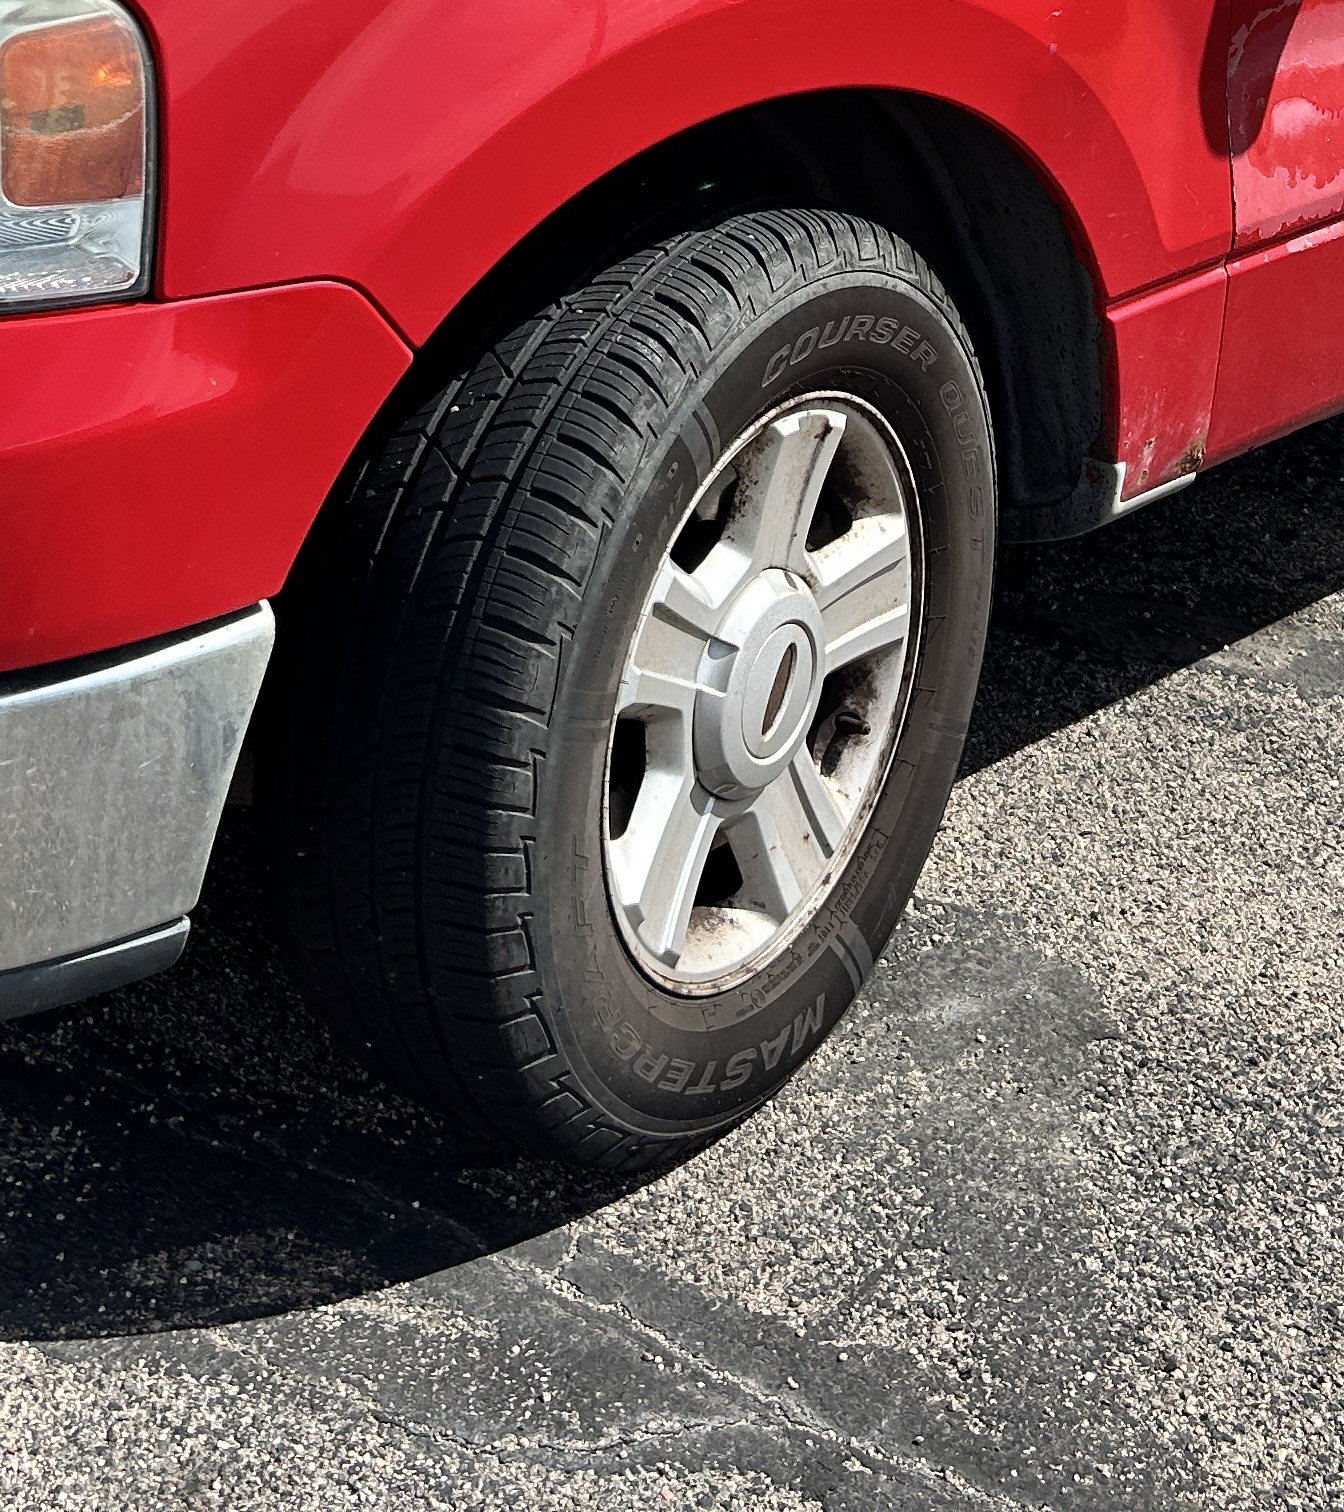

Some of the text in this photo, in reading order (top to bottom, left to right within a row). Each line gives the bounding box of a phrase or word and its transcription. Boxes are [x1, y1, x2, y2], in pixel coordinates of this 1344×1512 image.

[760, 313, 939, 389] COURSER
[938, 378, 987, 560] QUEST
[570, 832, 827, 1097] MASTERCRAFT
